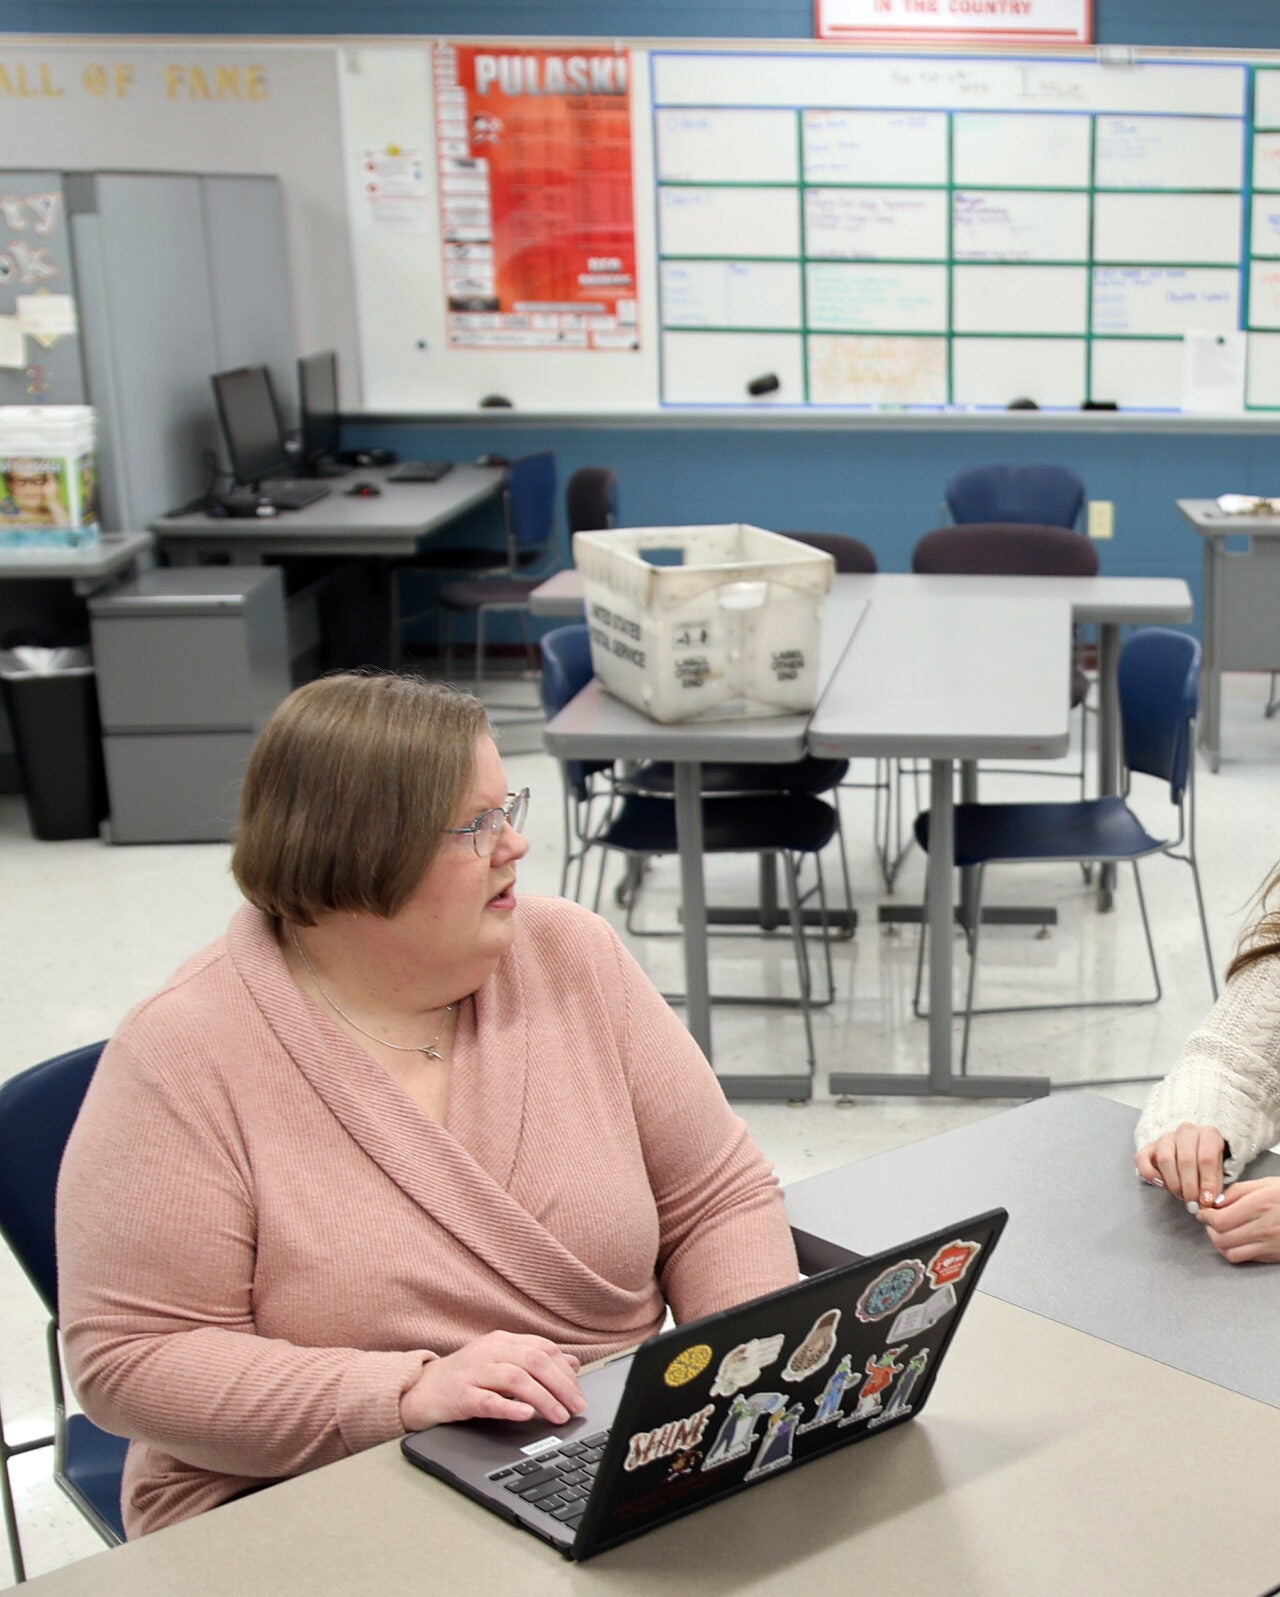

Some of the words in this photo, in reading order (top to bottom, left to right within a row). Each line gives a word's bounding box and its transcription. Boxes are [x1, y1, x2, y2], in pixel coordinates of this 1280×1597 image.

[874, 0, 892, 12] IN
[904, 0, 938, 13] THE
[948, 0, 1031, 15] COUNTRY
[82, 63, 135, 99] OF
[166, 64, 268, 100] FAME
[473, 54, 627, 97] PULASKI
[613, 614, 641, 641] STATES
[613, 638, 646, 668] SERVICE
